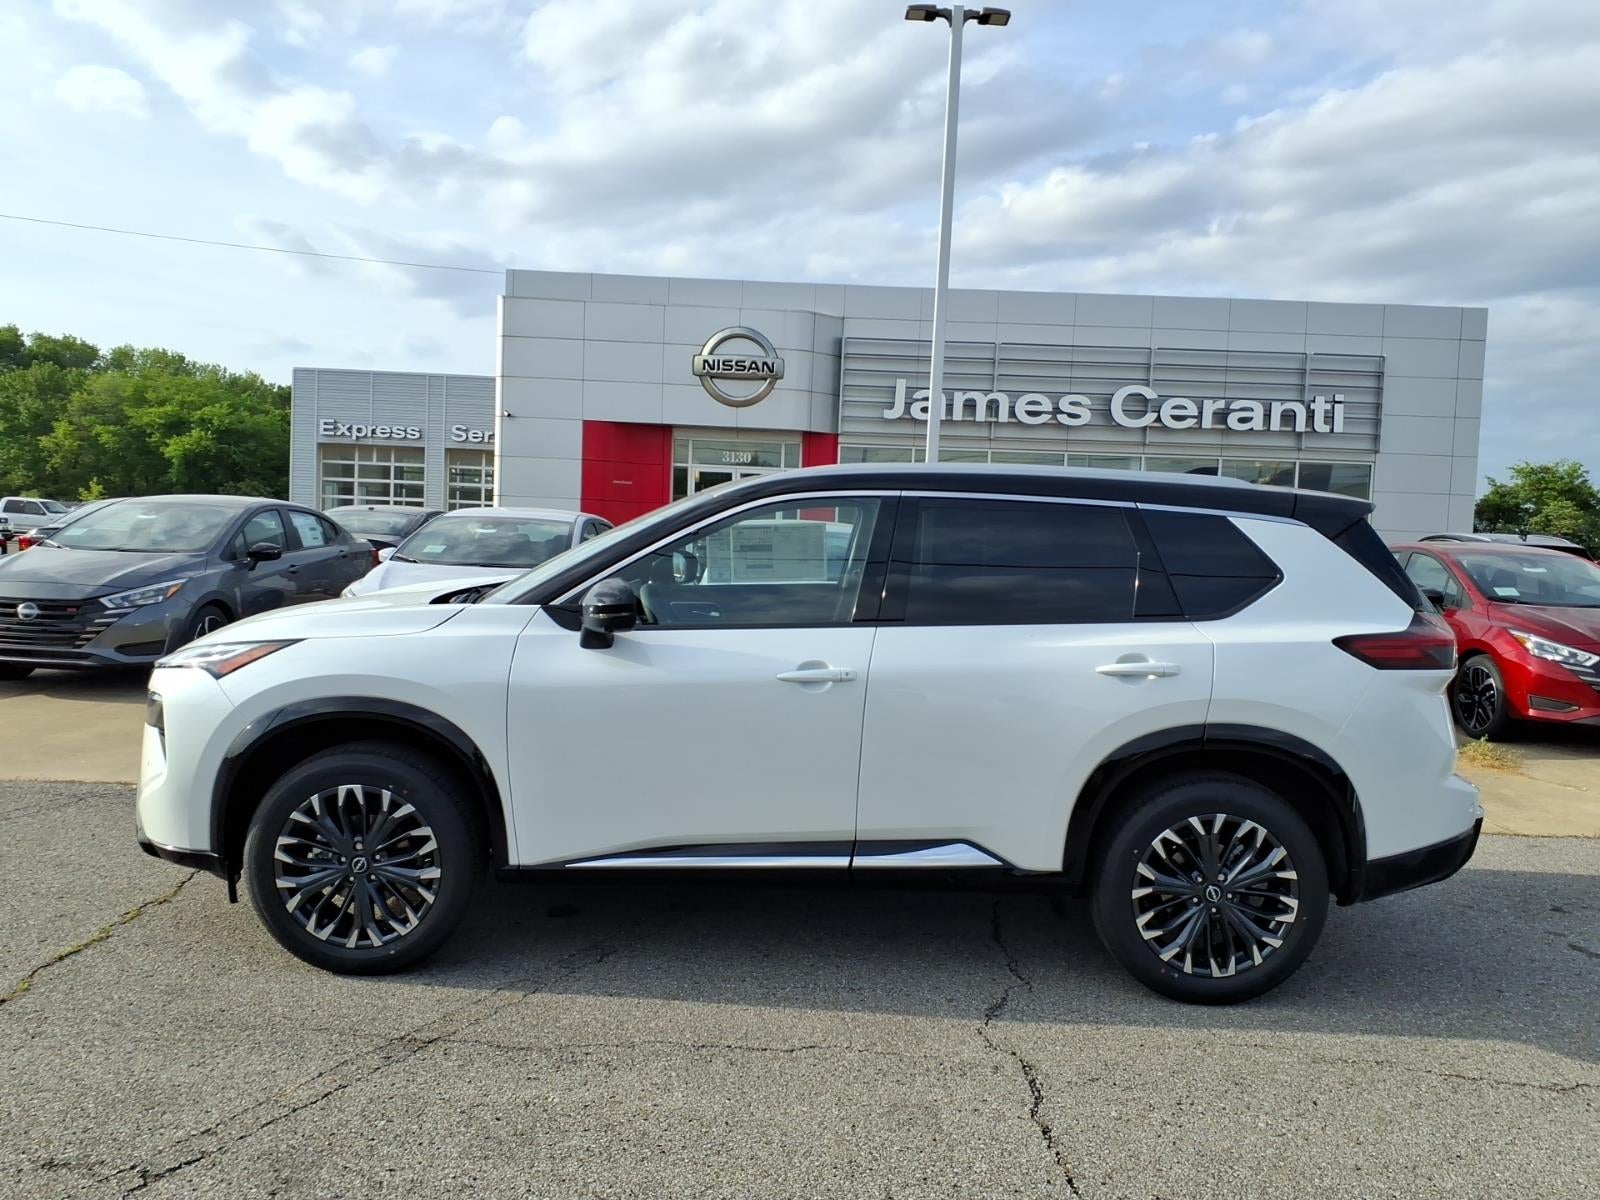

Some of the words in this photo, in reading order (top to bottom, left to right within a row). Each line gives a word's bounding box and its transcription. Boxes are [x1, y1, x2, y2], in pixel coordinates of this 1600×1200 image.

[702, 359, 775, 373] NISSAN
[883, 378, 1092, 426] James
[1110, 384, 1345, 433] Ceranti
[319, 418, 421, 440] Express
[722, 450, 752, 464] 3130
